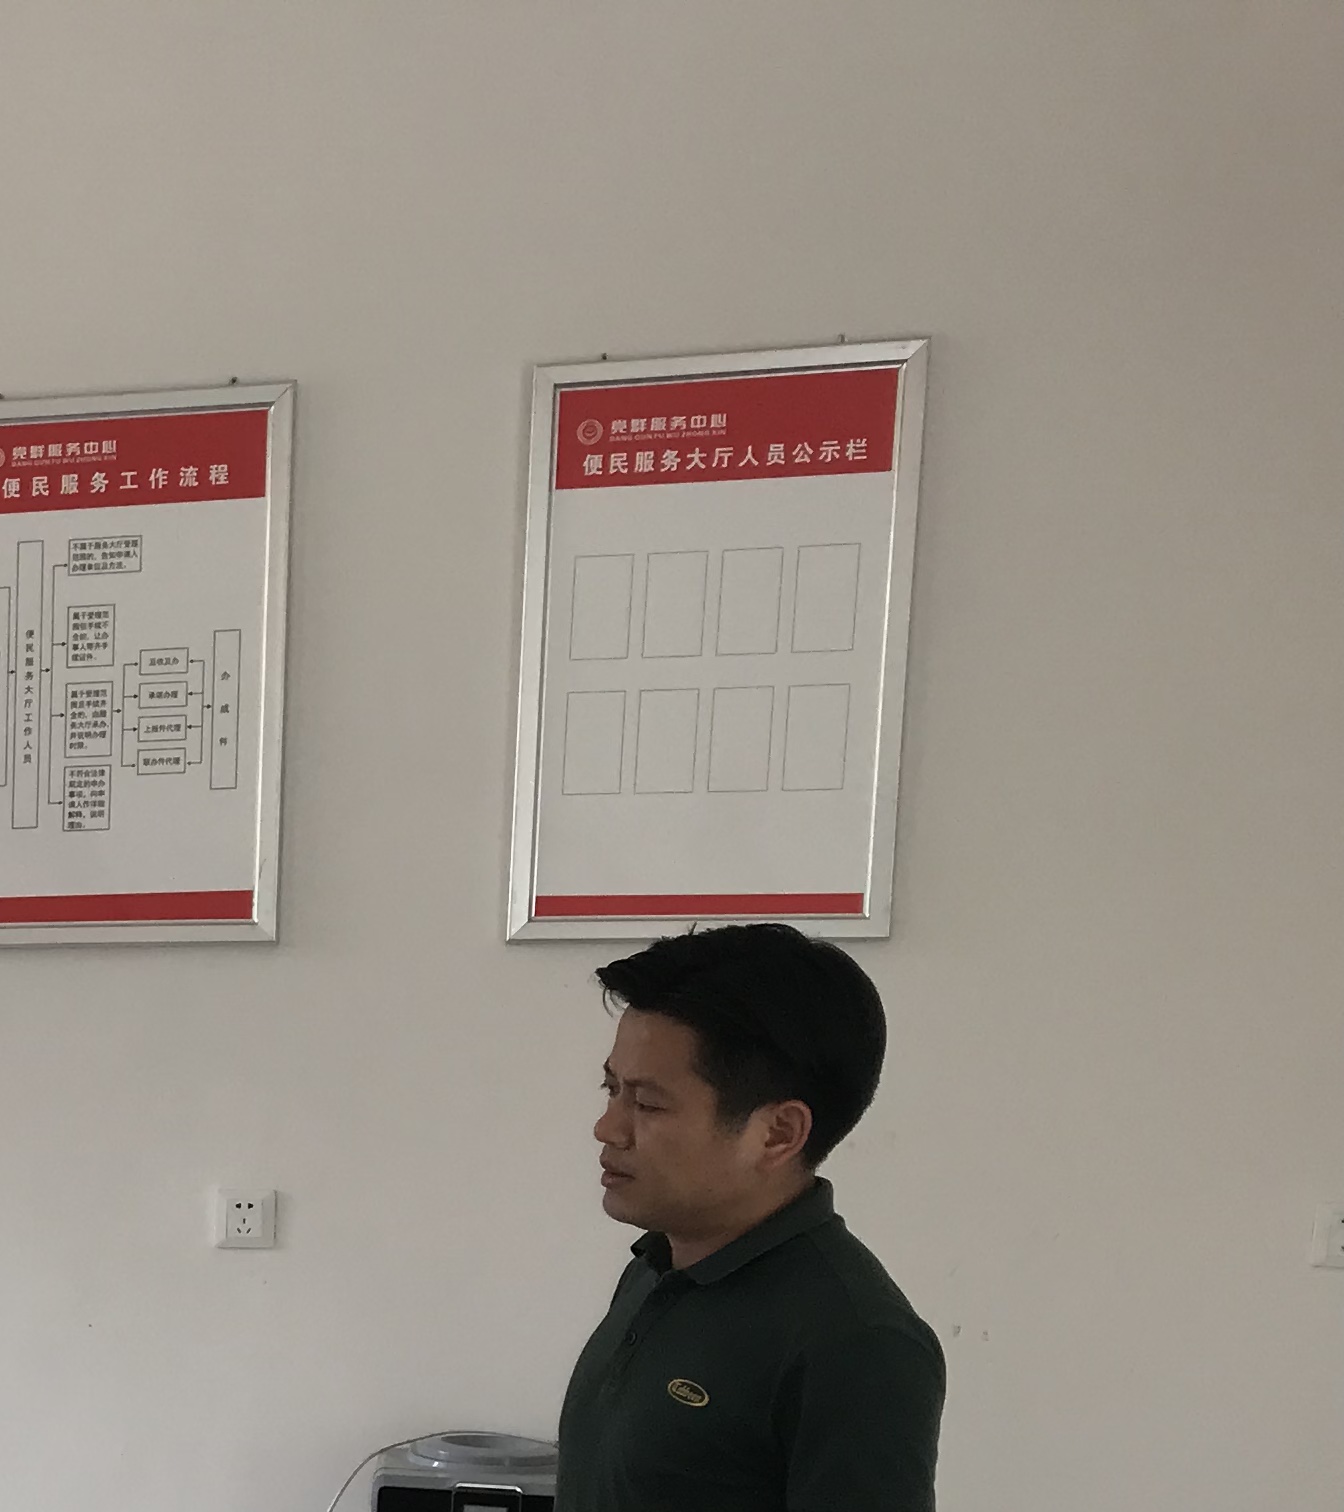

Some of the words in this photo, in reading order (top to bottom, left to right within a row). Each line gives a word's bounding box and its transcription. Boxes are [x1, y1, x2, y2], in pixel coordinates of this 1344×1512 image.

[611, 413, 727, 435] 党群服务中心
[12, 440, 117, 460] 党群服务中心
[582, 438, 868, 476] 便民服务大厅人员公示栏
[2, 464, 229, 498] 便民服务工作流程
[23, 629, 35, 764] 便民服务大厅工作人员
